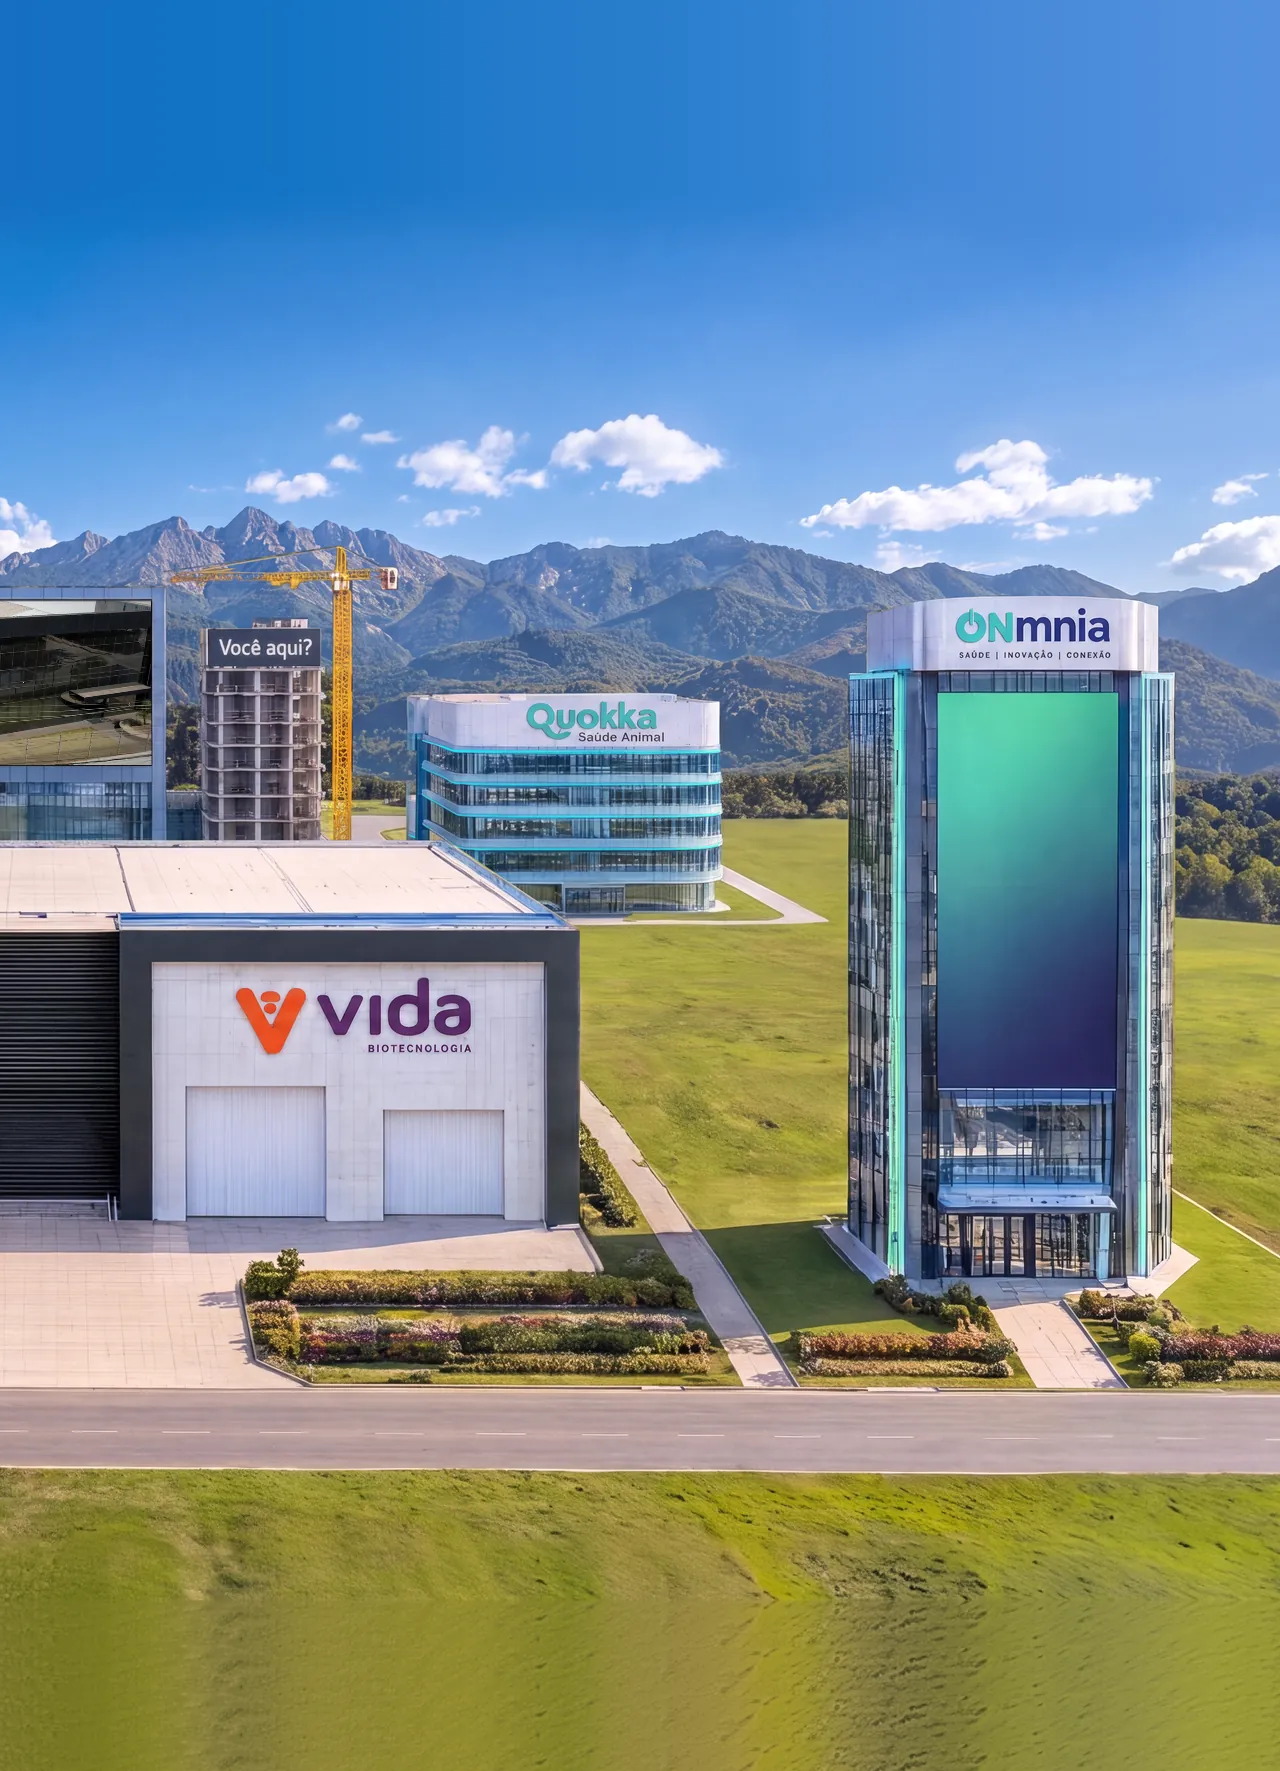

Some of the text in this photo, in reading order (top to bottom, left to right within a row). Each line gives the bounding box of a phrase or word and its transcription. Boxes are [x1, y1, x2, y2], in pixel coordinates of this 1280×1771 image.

[219, 639, 313, 660] Você aqui?
[959, 650, 991, 659] SAÚDE
[1066, 650, 1111, 659] CONEXÃO
[526, 701, 657, 740] Quokka
[578, 732, 665, 742] Saúde Animal
[317, 977, 472, 1036] vida
[368, 1044, 472, 1053] BIOTECNOLOGIA
